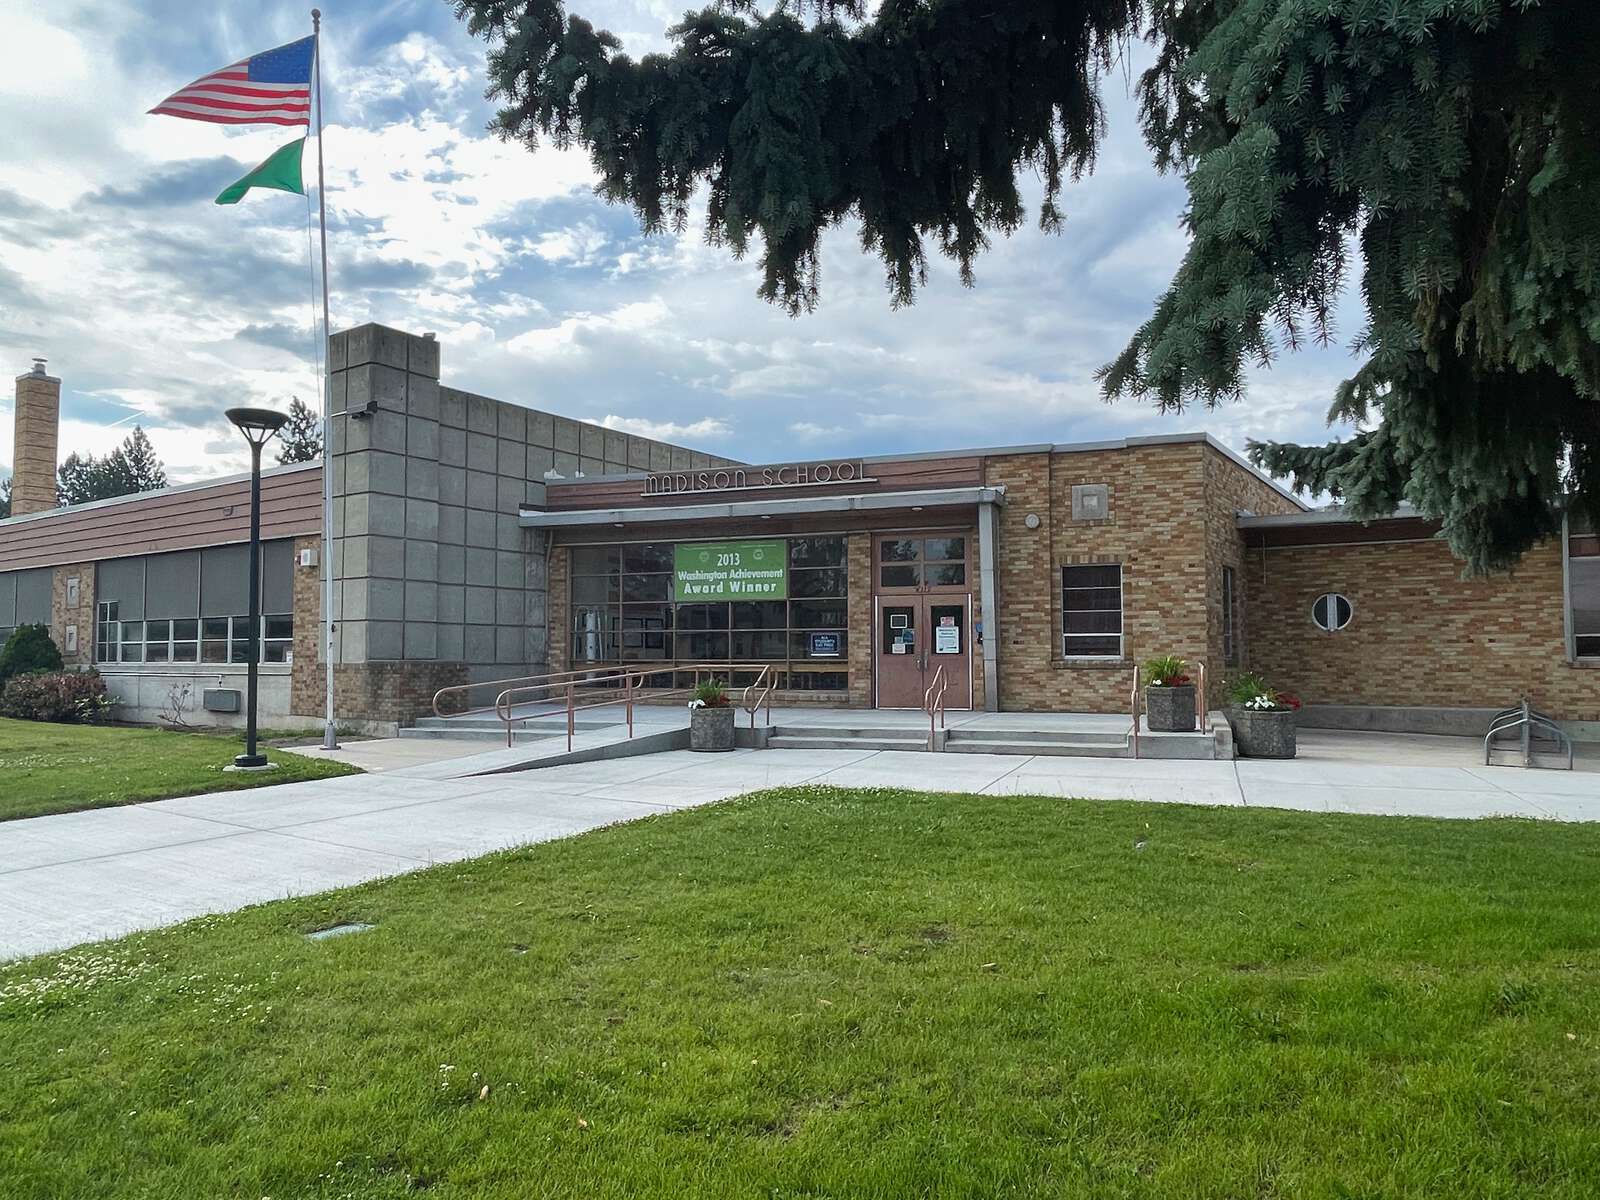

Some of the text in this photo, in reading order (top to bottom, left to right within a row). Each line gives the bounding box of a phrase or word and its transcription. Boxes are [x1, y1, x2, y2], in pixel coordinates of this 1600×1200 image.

[643, 461, 870, 493] MADISON SCHOOL
[717, 552, 740, 566] 2013
[678, 568, 783, 582] Washington Achievement
[683, 581, 777, 594] Award Winner
